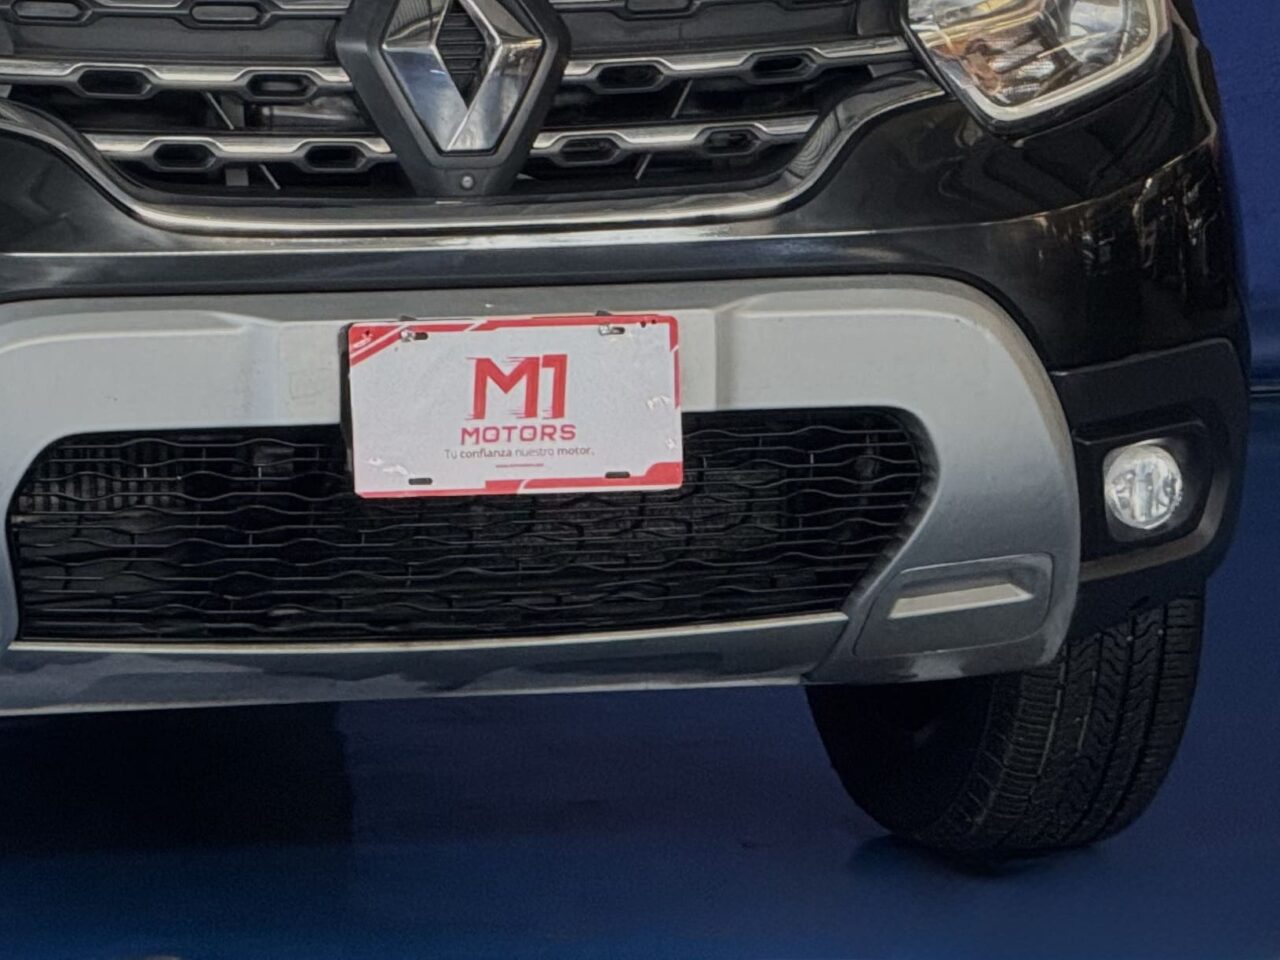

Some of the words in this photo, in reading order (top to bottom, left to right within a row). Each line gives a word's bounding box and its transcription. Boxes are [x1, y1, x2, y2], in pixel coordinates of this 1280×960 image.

[466, 354, 568, 420] M1
[461, 424, 577, 445] MOTORS
[444, 449, 458, 460] Tu
[460, 446, 512, 459] confianza
[515, 447, 554, 458] nuestro
